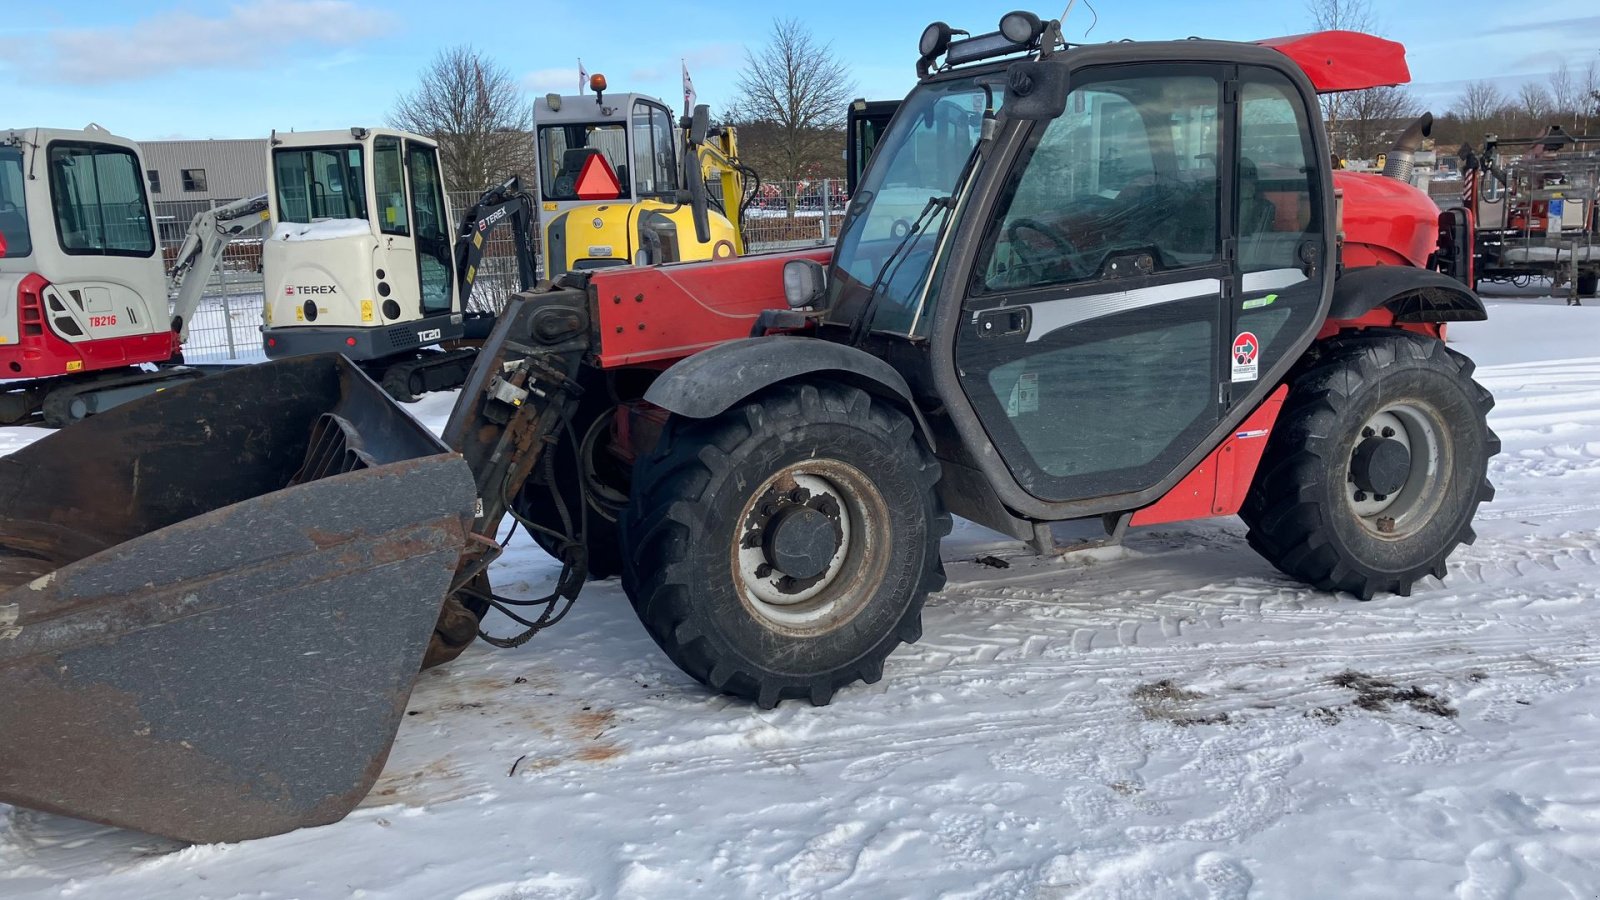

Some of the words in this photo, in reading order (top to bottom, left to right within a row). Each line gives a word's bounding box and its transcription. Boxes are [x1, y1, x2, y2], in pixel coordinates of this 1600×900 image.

[485, 205, 507, 226] TEREX
[296, 285, 337, 295] TEREX
[88, 314, 117, 328] TB216
[417, 328, 441, 343] TC20
